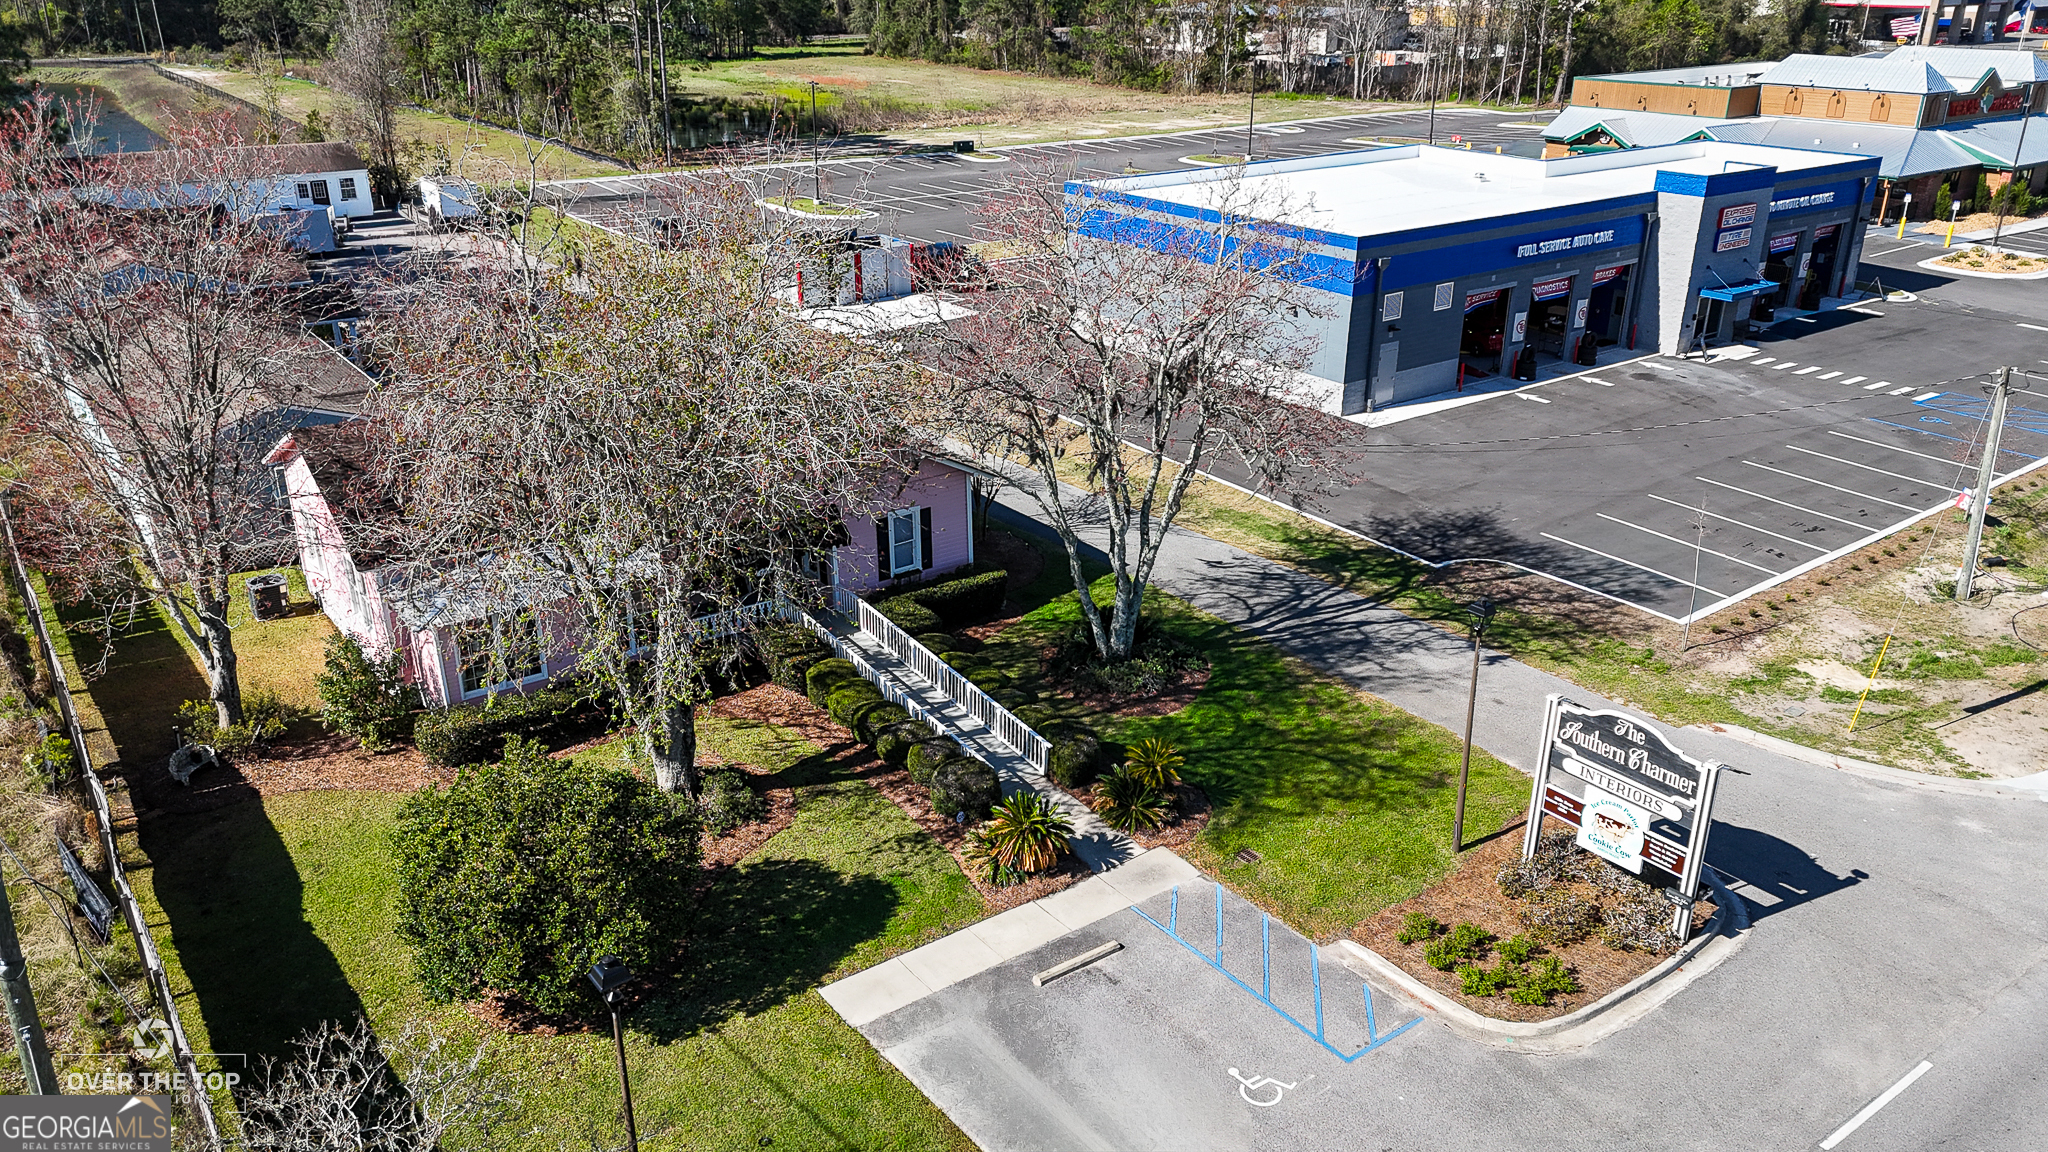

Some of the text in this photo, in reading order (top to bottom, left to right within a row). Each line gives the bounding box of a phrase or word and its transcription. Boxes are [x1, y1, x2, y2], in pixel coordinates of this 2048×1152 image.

[1725, 206, 1756, 218] EXPRESS
[1517, 229, 1615, 258] FULL SERVICE AUTO CARE
[1728, 231, 1743, 239] TIRE
[1595, 268, 1616, 280] BRAKES
[1532, 280, 1568, 294] DIAGNOSTICS
[1614, 720, 1646, 745] The
[1560, 722, 1697, 795] Southern Charmer
[1580, 765, 1664, 812] INTERIORS
[1590, 801, 1600, 809] Ice
[1601, 799, 1623, 809] Cream
[1623, 808, 1640, 828] Parlor
[1588, 833, 1613, 850] Cookie
[1615, 846, 1632, 858] Cow
